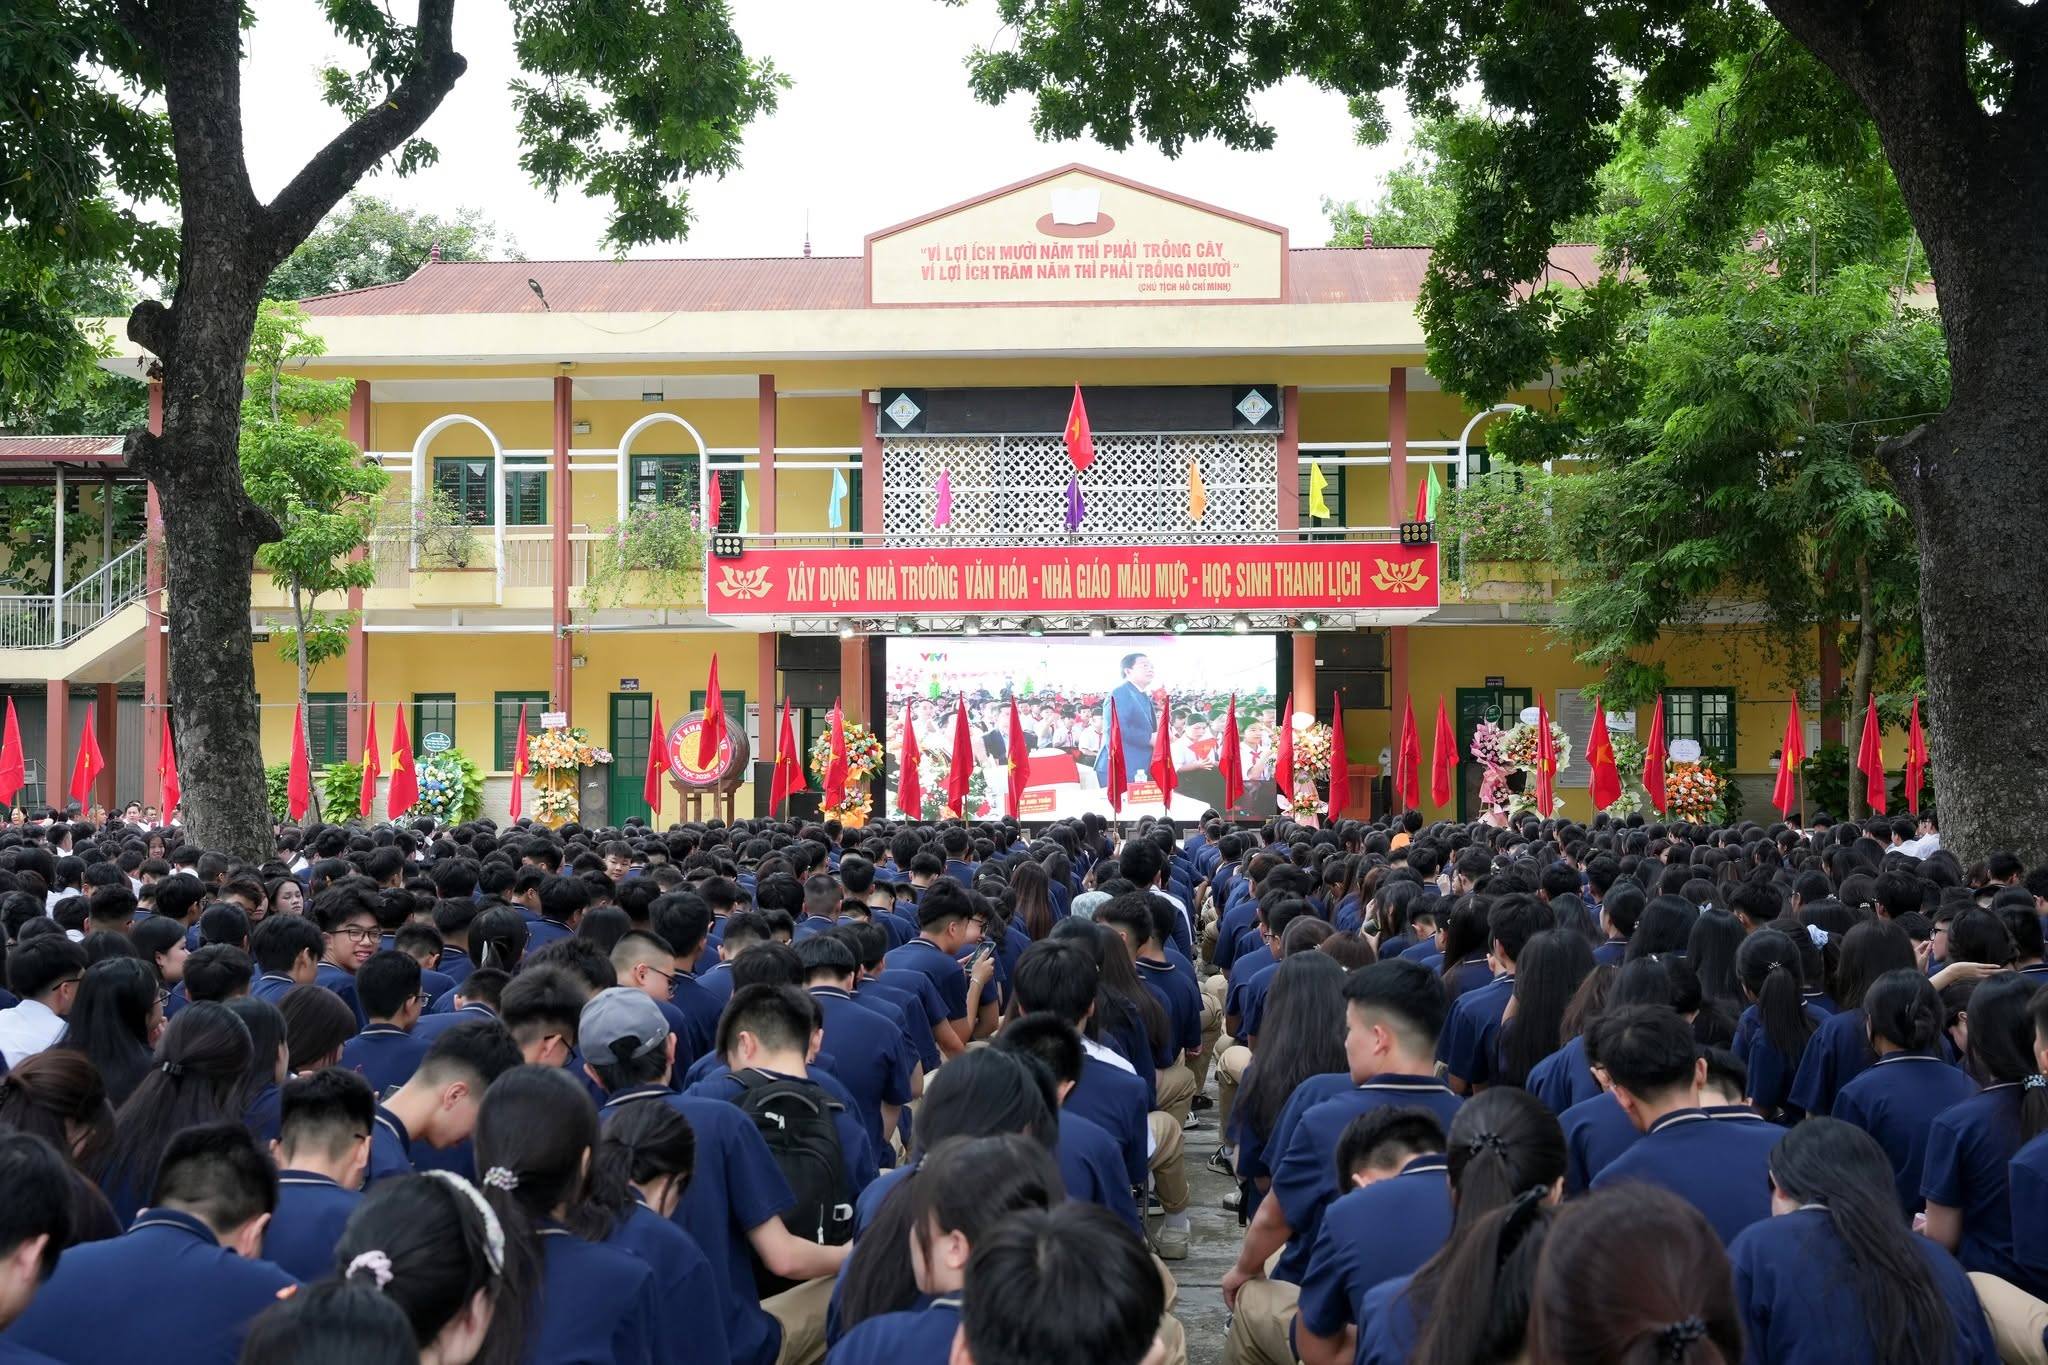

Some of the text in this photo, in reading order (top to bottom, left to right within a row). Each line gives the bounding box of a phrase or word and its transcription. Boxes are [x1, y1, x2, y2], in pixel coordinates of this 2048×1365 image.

[945, 243, 967, 262] LỢI
[972, 241, 995, 261] ÍCH
[1000, 241, 1037, 260] MƯỜI
[1040, 242, 1073, 259] NĂM
[1104, 239, 1136, 259] PHẢI
[1143, 239, 1191, 258] TRỒNG
[1196, 240, 1223, 258] CÂY
[939, 263, 961, 283] LỢI
[993, 262, 1032, 279] TRĂM
[1037, 262, 1070, 279] NĂM
[1100, 259, 1132, 278] PHẢI
[1136, 259, 1183, 278] TRỒNG
[1160, 282, 1176, 293] TỊCH
[1179, 280, 1190, 291] HỒ
[1192, 279, 1205, 291] CHÍ
[787, 560, 816, 601] XÂY
[819, 563, 859, 607] DỰNG
[866, 560, 897, 600] NHÀ
[900, 556, 959, 600] TRƯỜNG
[964, 558, 994, 600] VĂN
[998, 557, 1029, 599] HÓA
[1041, 557, 1072, 599] NHÀ
[1076, 557, 1111, 599] GIÁO
[1117, 552, 1150, 599] MẪU
[1155, 560, 1189, 605] MỰC
[1202, 562, 1232, 604] HỌC
[1236, 562, 1272, 597] SINH
[1274, 561, 1324, 597] THANH
[1328, 561, 1361, 602] LỊCH
[920, 652, 948, 662] VTV1
[682, 724, 702, 736] KHA
